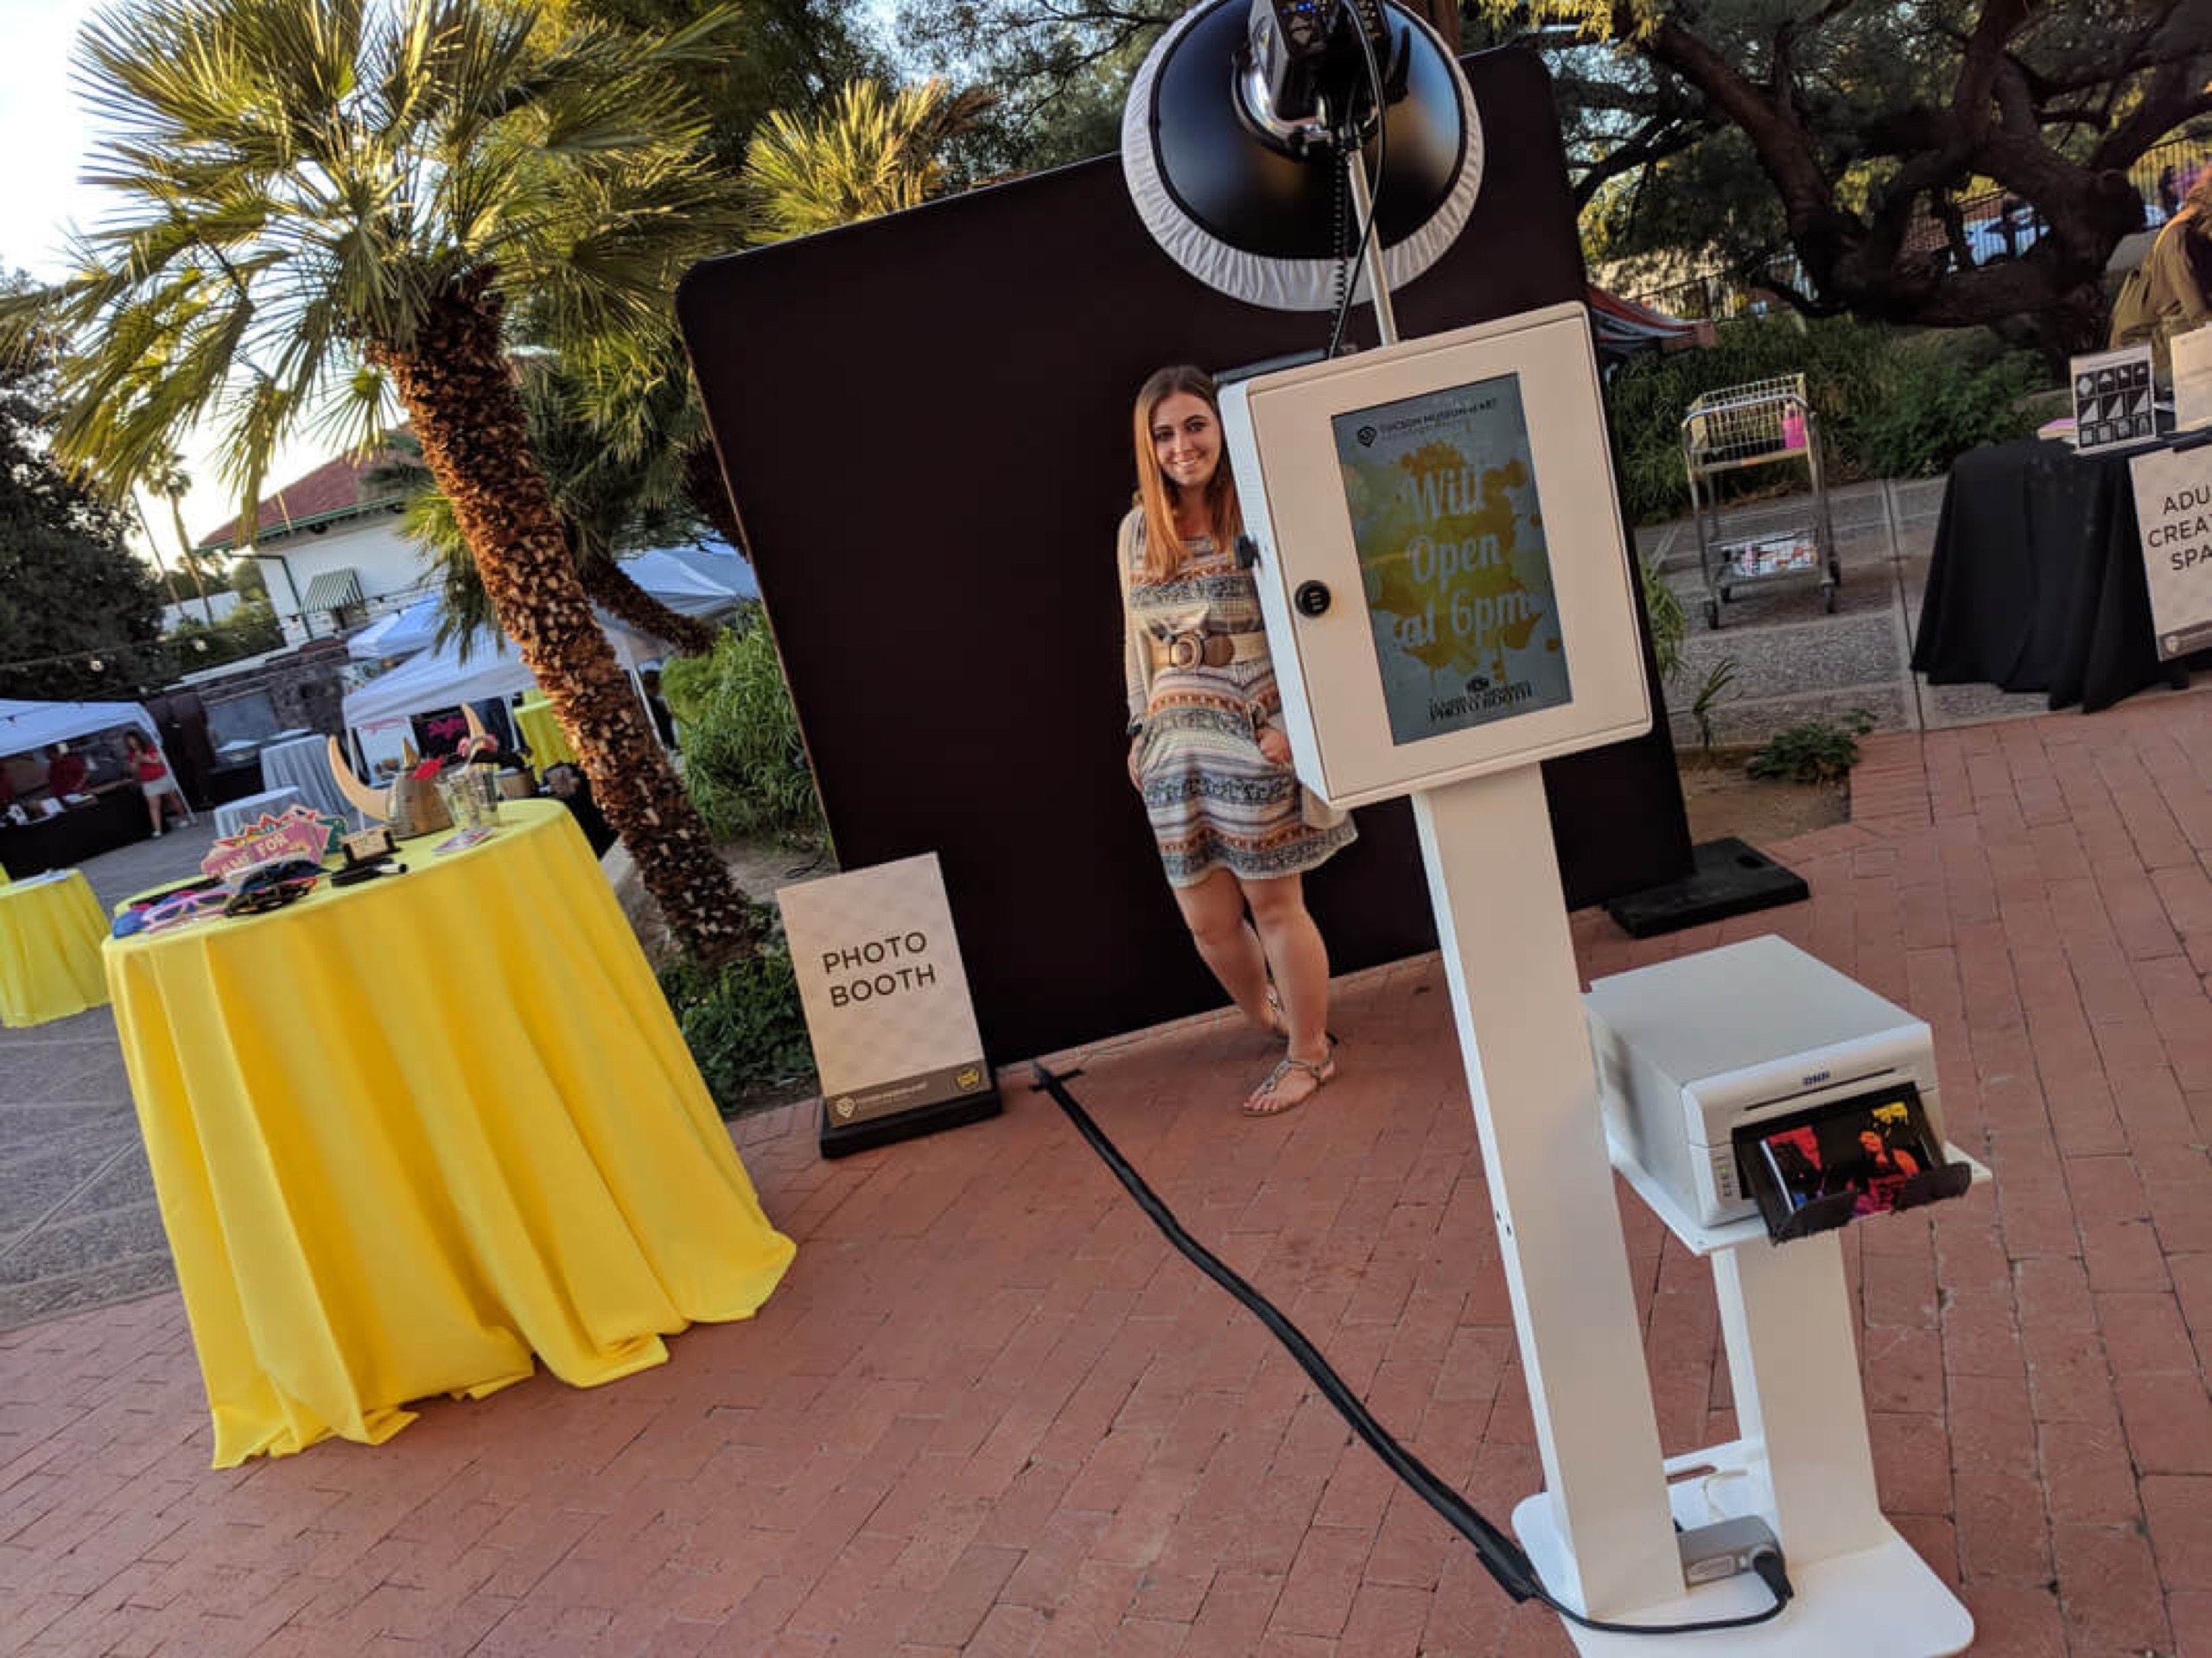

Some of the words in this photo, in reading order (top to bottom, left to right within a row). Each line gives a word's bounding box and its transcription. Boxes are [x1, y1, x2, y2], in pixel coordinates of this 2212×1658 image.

[1401, 466, 1484, 522] Will
[2164, 485, 2210, 515] ADU
[2148, 514, 2212, 548] CREA
[1407, 533, 1502, 592] Open
[2171, 544, 2212, 570] SPA
[1451, 588, 1538, 649] 6pm
[256, 833, 289, 857] FOR
[822, 931, 926, 974] PHOTO
[830, 963, 936, 1007] BOOTH
